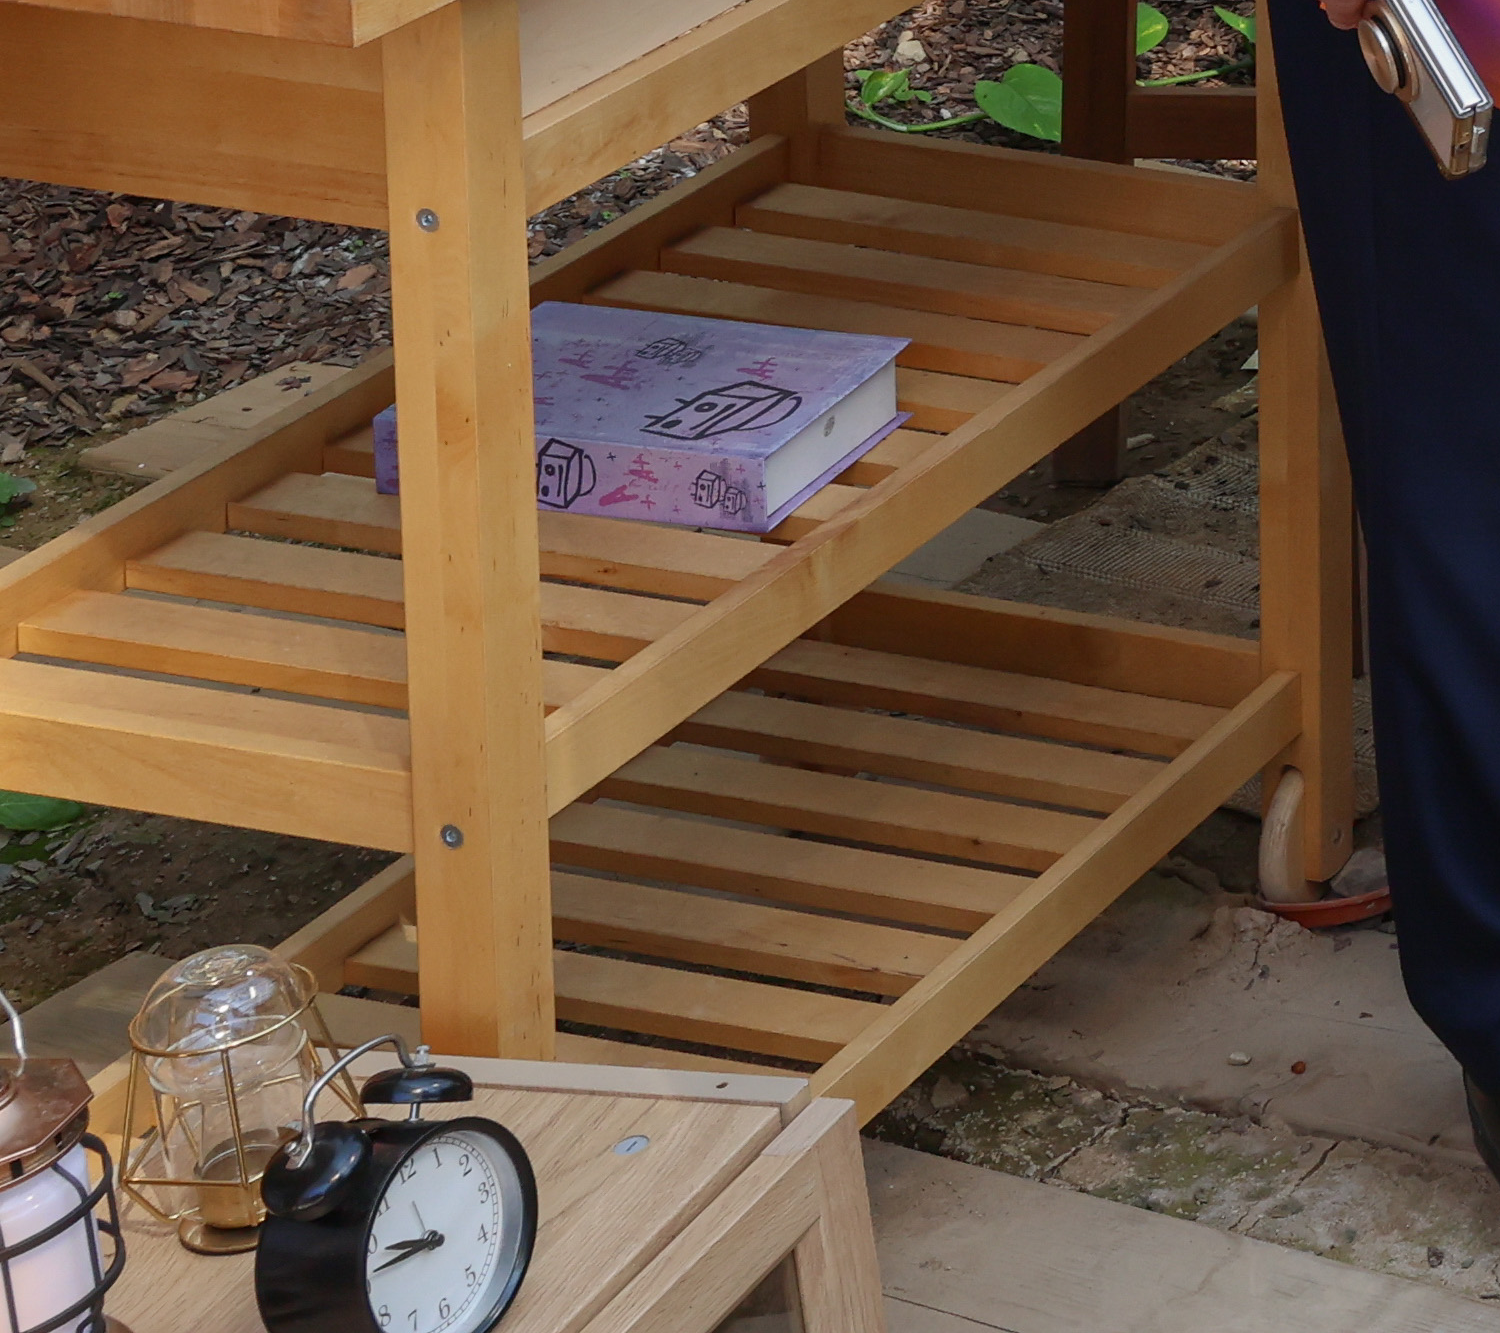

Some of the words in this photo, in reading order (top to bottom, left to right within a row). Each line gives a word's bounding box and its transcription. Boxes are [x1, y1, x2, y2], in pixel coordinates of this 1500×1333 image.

[432, 1148, 443, 1169] 1
[459, 1154, 473, 1177] 2
[399, 1158, 417, 1184] 12
[478, 1182, 489, 1204] 3
[477, 1223, 489, 1244] 4
[465, 1264, 477, 1287] 5
[378, 1304, 392, 1327] 8
[407, 1309, 417, 1331] 7
[438, 1298, 450, 1320] 6
